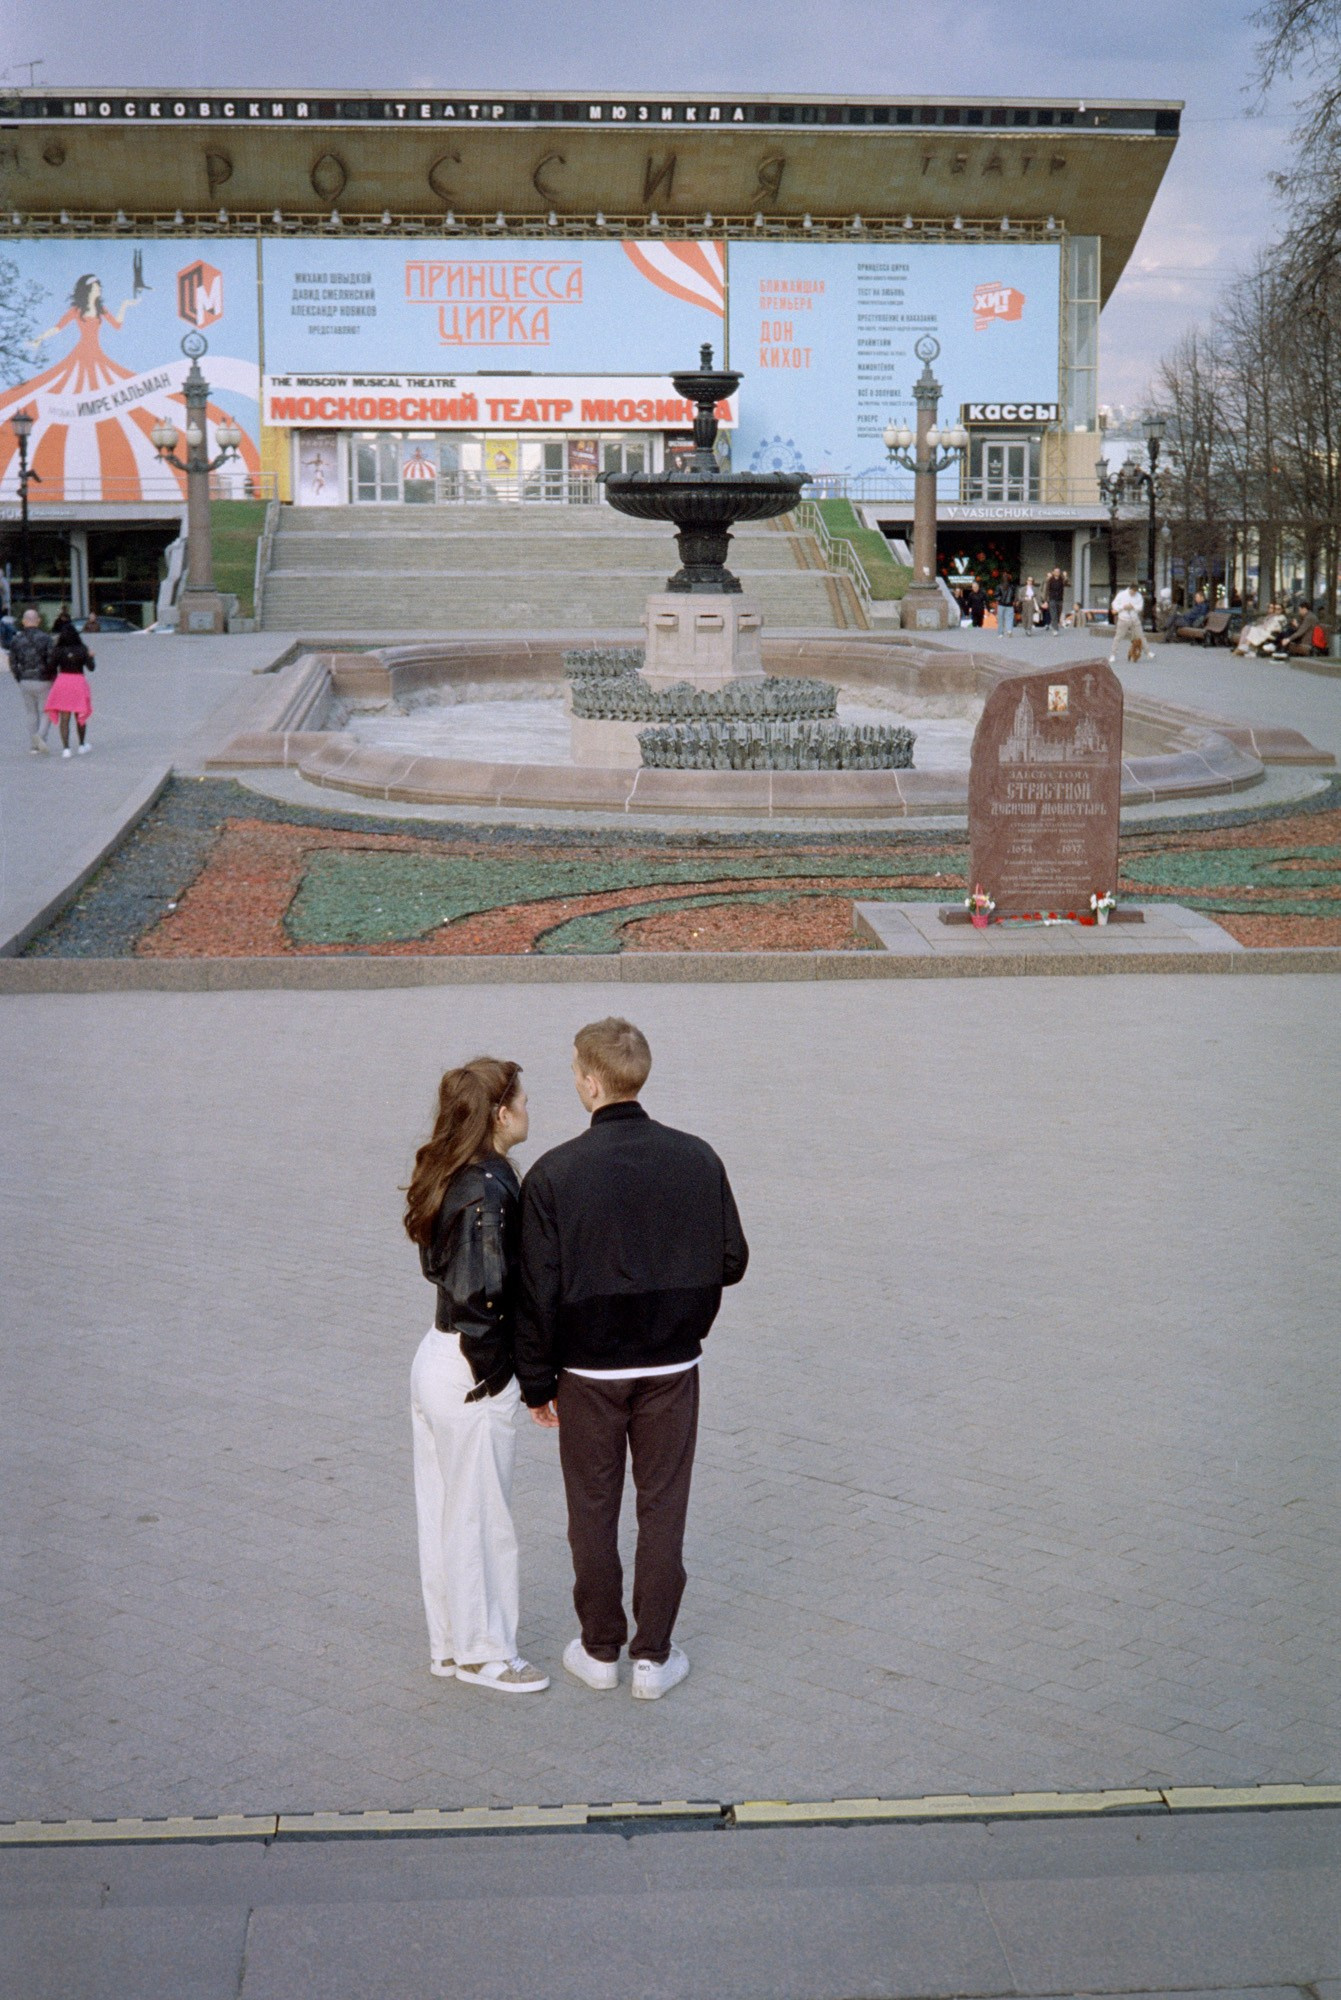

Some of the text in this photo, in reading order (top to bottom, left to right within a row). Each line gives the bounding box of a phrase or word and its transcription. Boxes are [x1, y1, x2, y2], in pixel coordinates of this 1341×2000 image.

[74, 102, 744, 121] МОСКОВСКИЙ ТЕАТР МЮЗИКЛА
[204, 151, 786, 204] РОССИЯ
[405, 265, 582, 301] ПРИНЦЕССА
[760, 278, 825, 293] БЛИЖАЙШАЯ
[292, 289, 320, 300] ДАВИД
[760, 297, 812, 310] ПРЕМЬЕРА
[291, 305, 337, 317] АЛЕКСАНДР
[438, 306, 549, 344] ЦИРКА
[760, 321, 793, 343] ДОН
[760, 347, 812, 368] КИХОТ
[271, 378, 456, 388] THE MOSCOW MUSICAL THEATRE
[77, 372, 171, 417] ИМРЕ КАЛЬМАН
[271, 392, 732, 422] МОСКОВСКИЙ ТЕАТР МЮЗИКА
[962, 507, 1033, 518] VASILCHUKI
